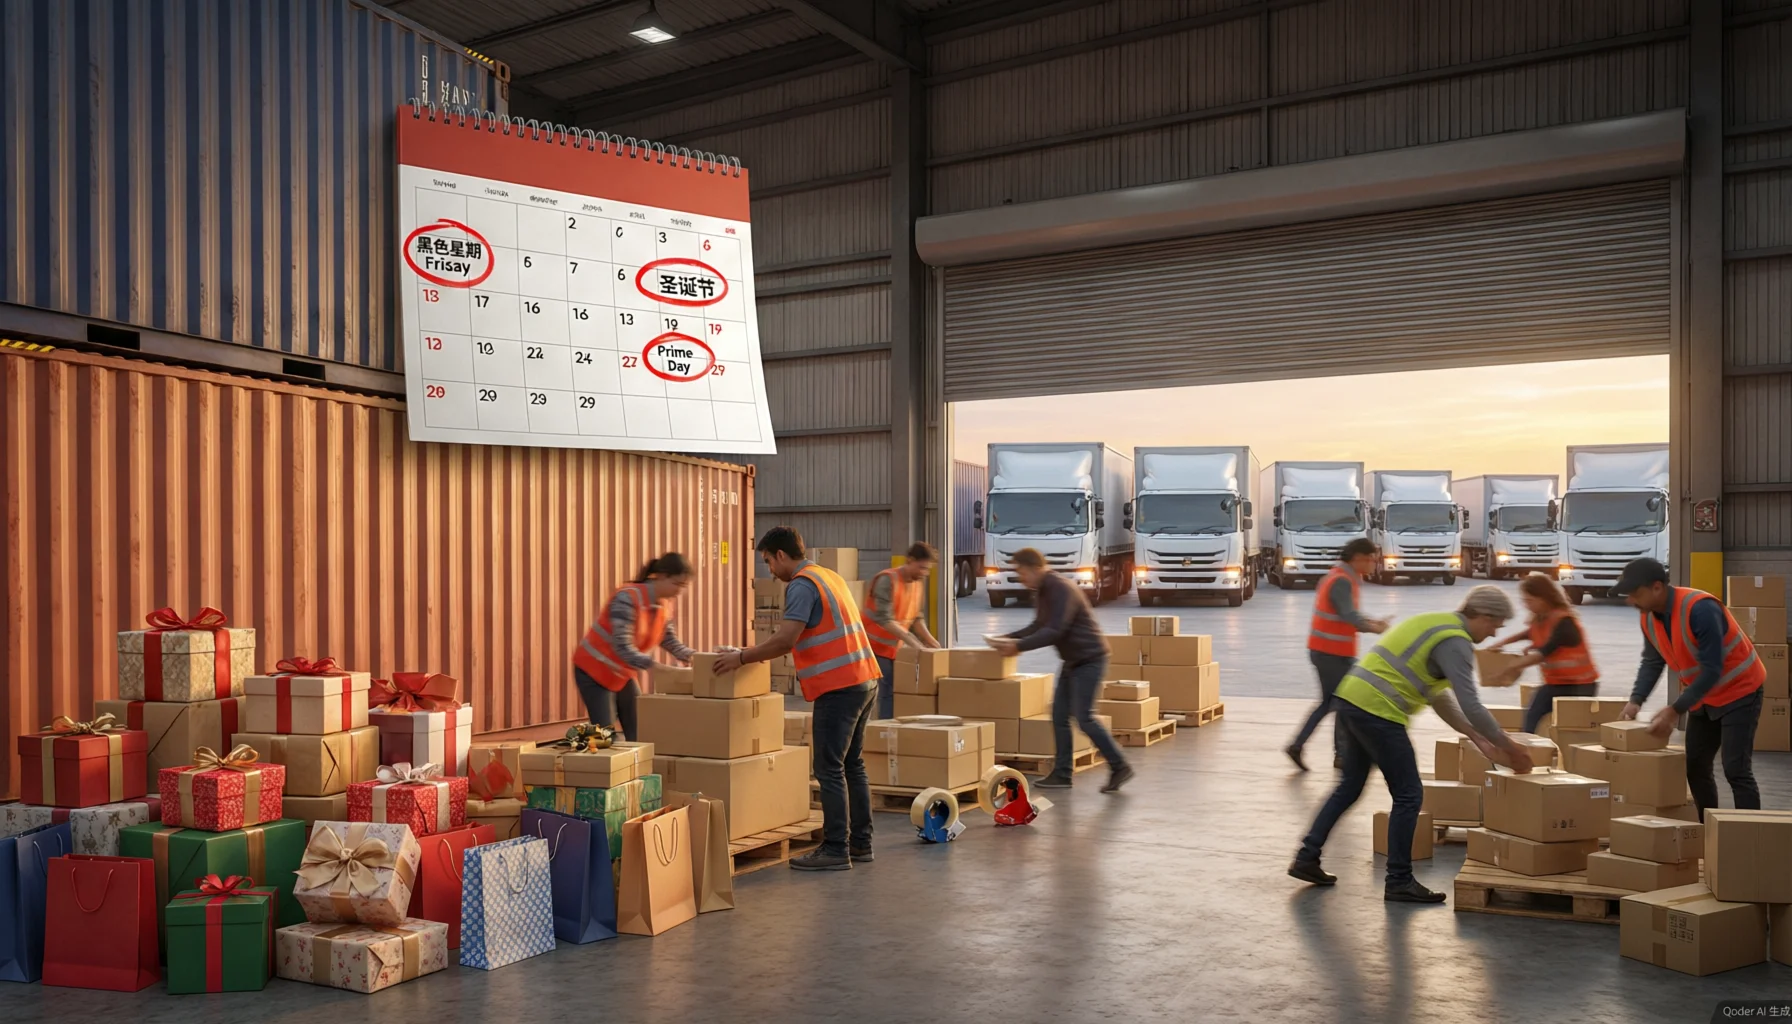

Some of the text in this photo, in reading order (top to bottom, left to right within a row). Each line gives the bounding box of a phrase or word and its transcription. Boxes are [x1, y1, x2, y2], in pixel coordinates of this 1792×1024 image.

[568, 216, 577, 230] 2
[658, 231, 667, 244] 3
[703, 239, 712, 251] 6
[417, 236, 482, 259] 黑色星期
[425, 256, 471, 277] Frisay
[569, 261, 579, 274] 7
[617, 268, 626, 281] 6
[659, 275, 715, 298] 圣诞节
[474, 294, 490, 308] 17
[524, 301, 541, 315] 16
[619, 312, 634, 326] 13
[708, 323, 722, 335] 19
[657, 345, 694, 359] Prime
[667, 359, 691, 376] Day
[710, 364, 726, 376] 29
[578, 395, 596, 409] 29
